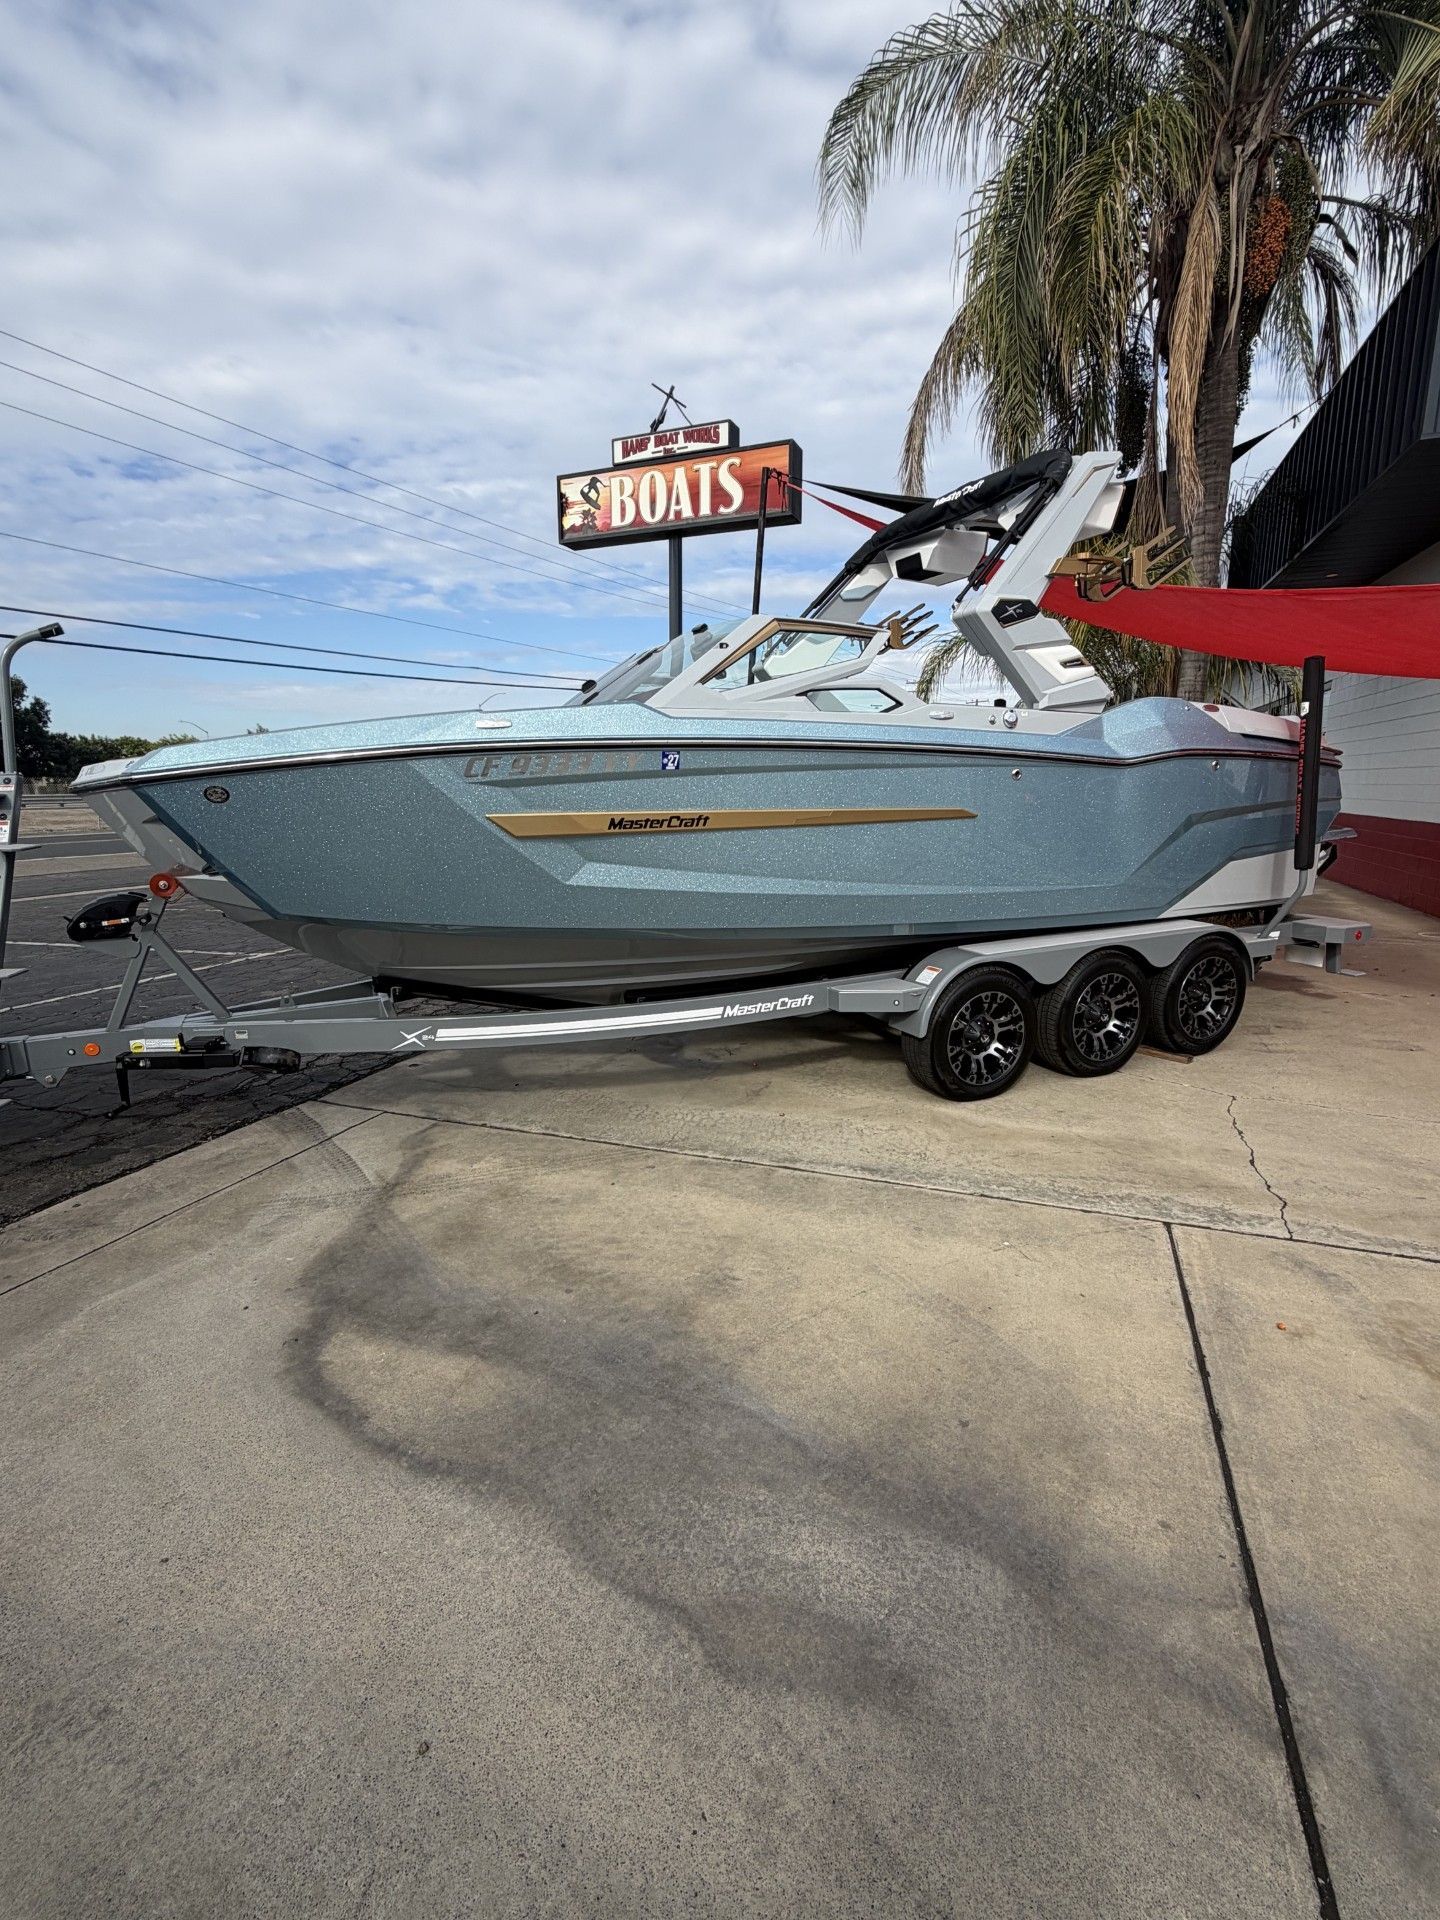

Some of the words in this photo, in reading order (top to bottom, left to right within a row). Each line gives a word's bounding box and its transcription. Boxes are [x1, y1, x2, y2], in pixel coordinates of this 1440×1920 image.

[654, 431, 680, 449] BOAT
[683, 424, 720, 445] WORKS
[609, 456, 745, 529] BOATS
[464, 756, 501, 778] CF
[667, 754, 680, 767] 27
[608, 814, 710, 831] MasterCraft
[723, 994, 815, 1018] MasterCraft
